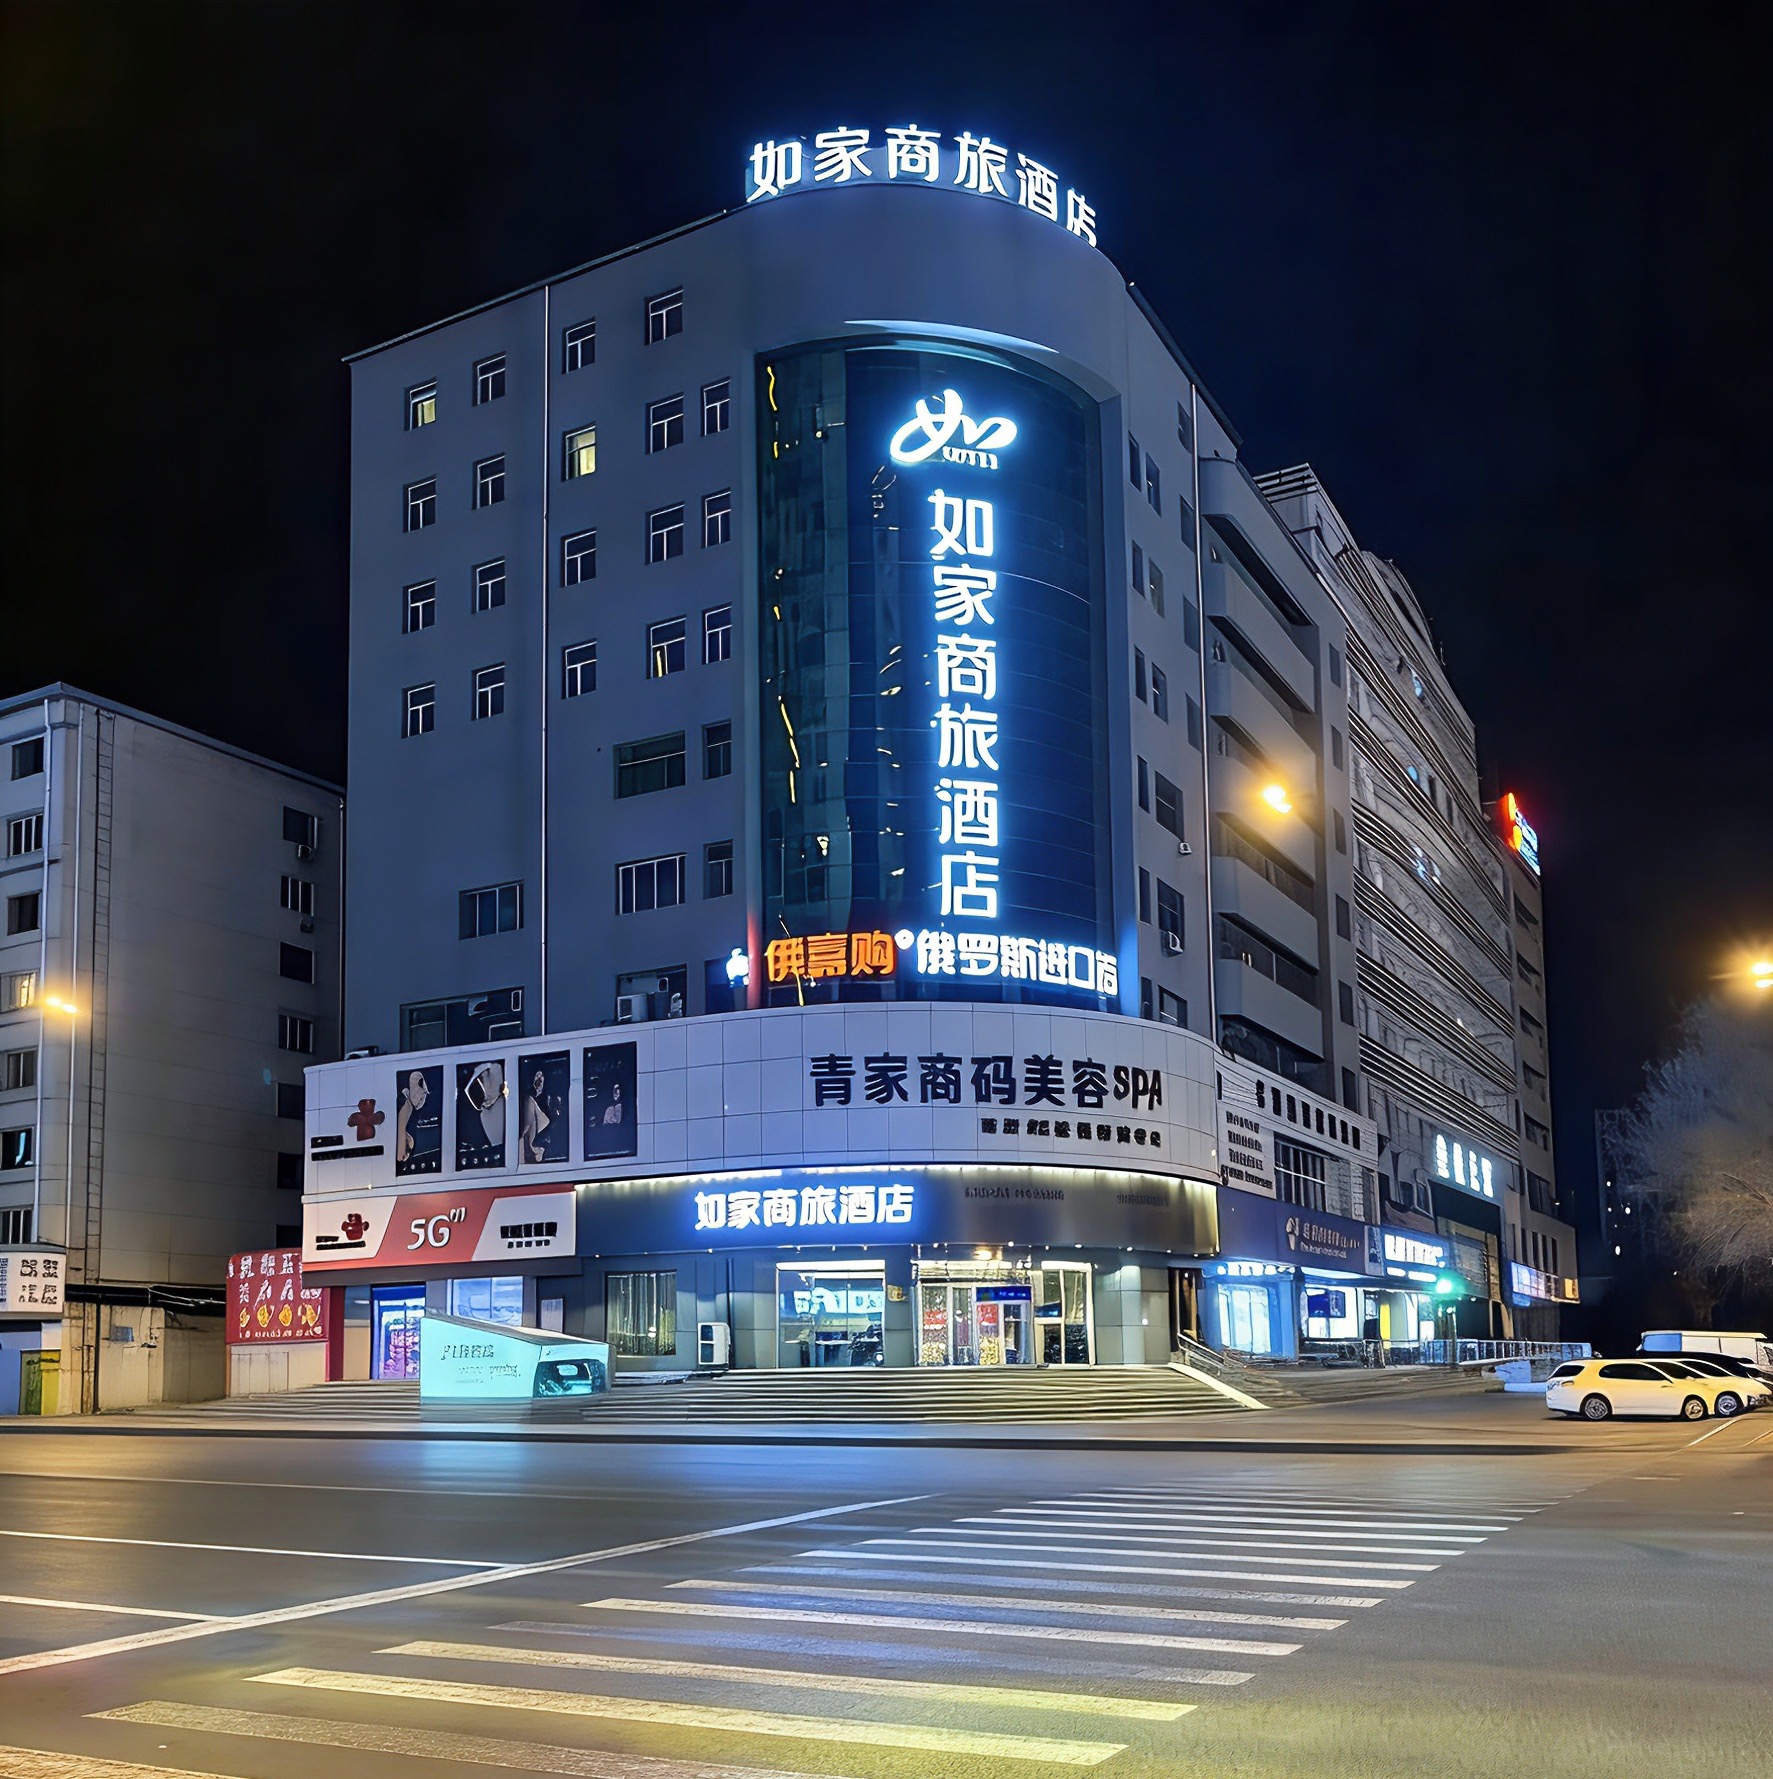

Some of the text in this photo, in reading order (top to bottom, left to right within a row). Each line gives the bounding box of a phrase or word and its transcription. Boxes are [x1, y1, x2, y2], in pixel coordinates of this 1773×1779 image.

[746, 124, 1097, 247] 如家商旅酒店
[929, 489, 999, 918] 如家商旅酒店
[694, 1184, 914, 1230] 如家商旅酒店
